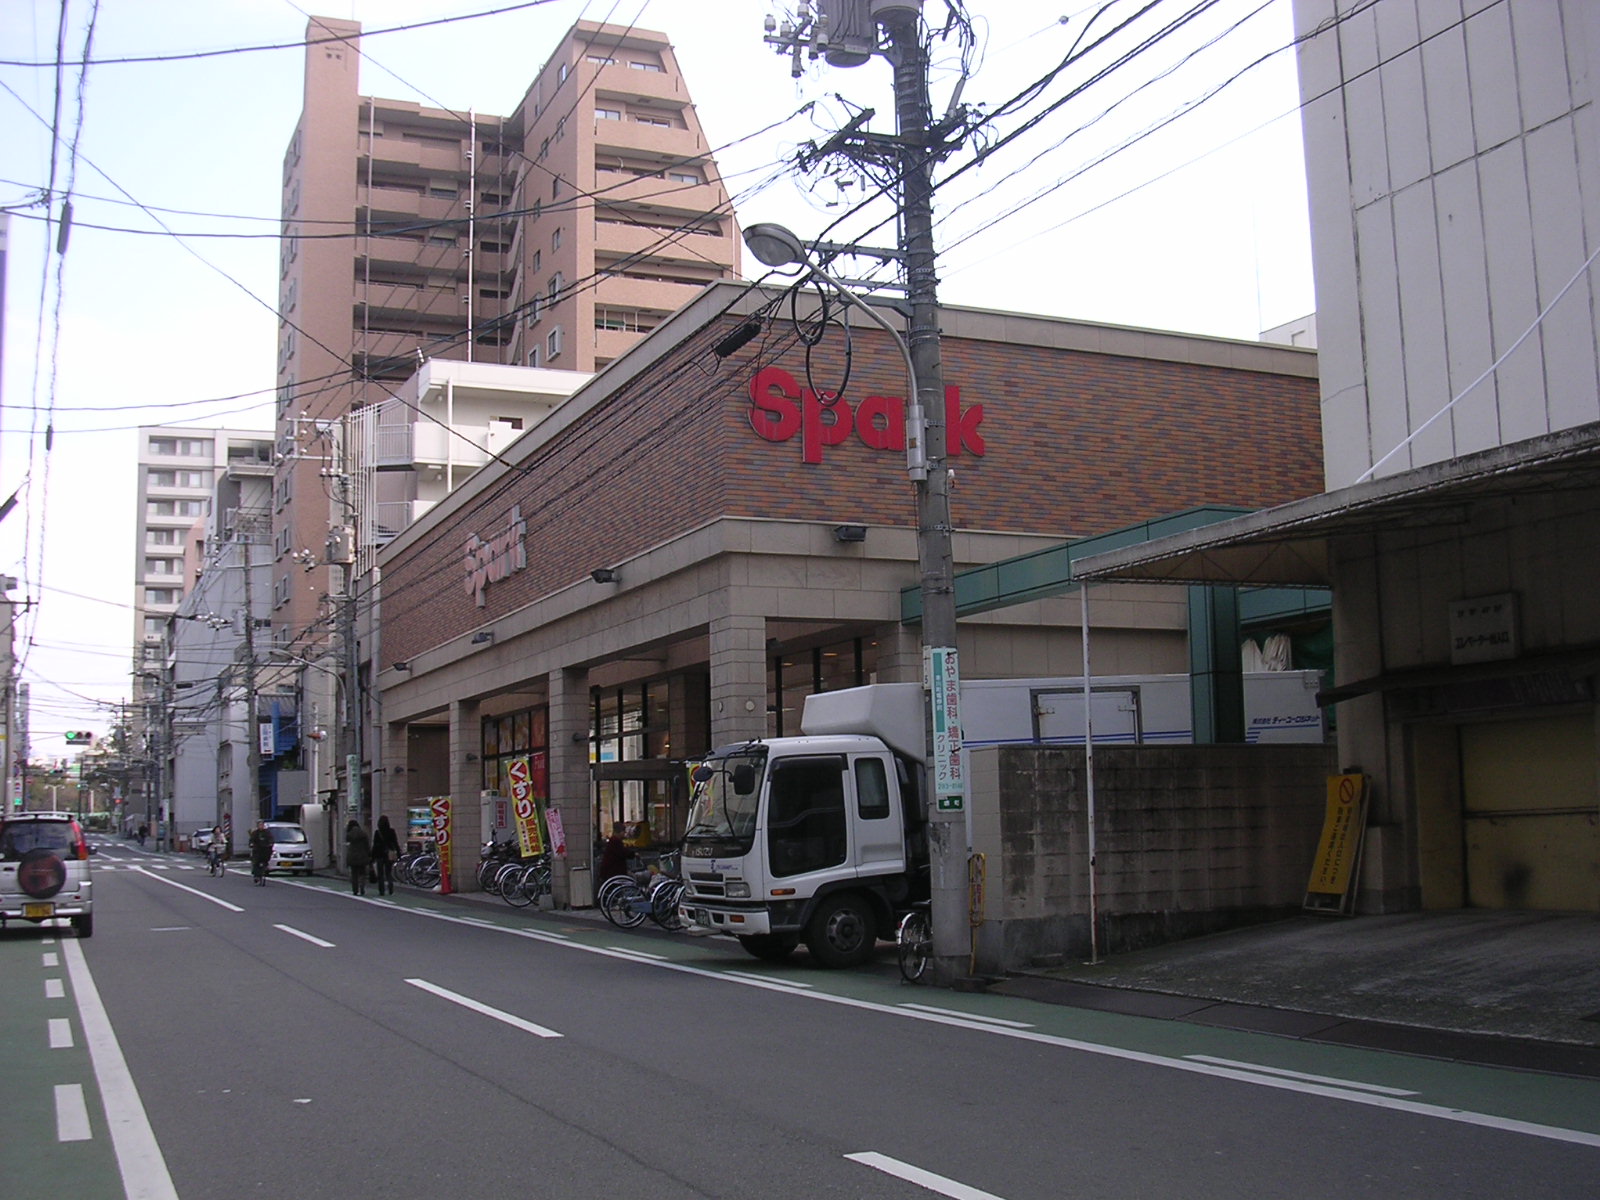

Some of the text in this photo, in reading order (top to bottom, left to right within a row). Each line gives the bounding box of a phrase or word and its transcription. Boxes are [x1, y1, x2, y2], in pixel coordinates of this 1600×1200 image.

[748, 366, 985, 464] Spak
[937, 734, 947, 781] クリニック
[510, 761, 533, 819] くすり
[432, 799, 449, 845] くすり
